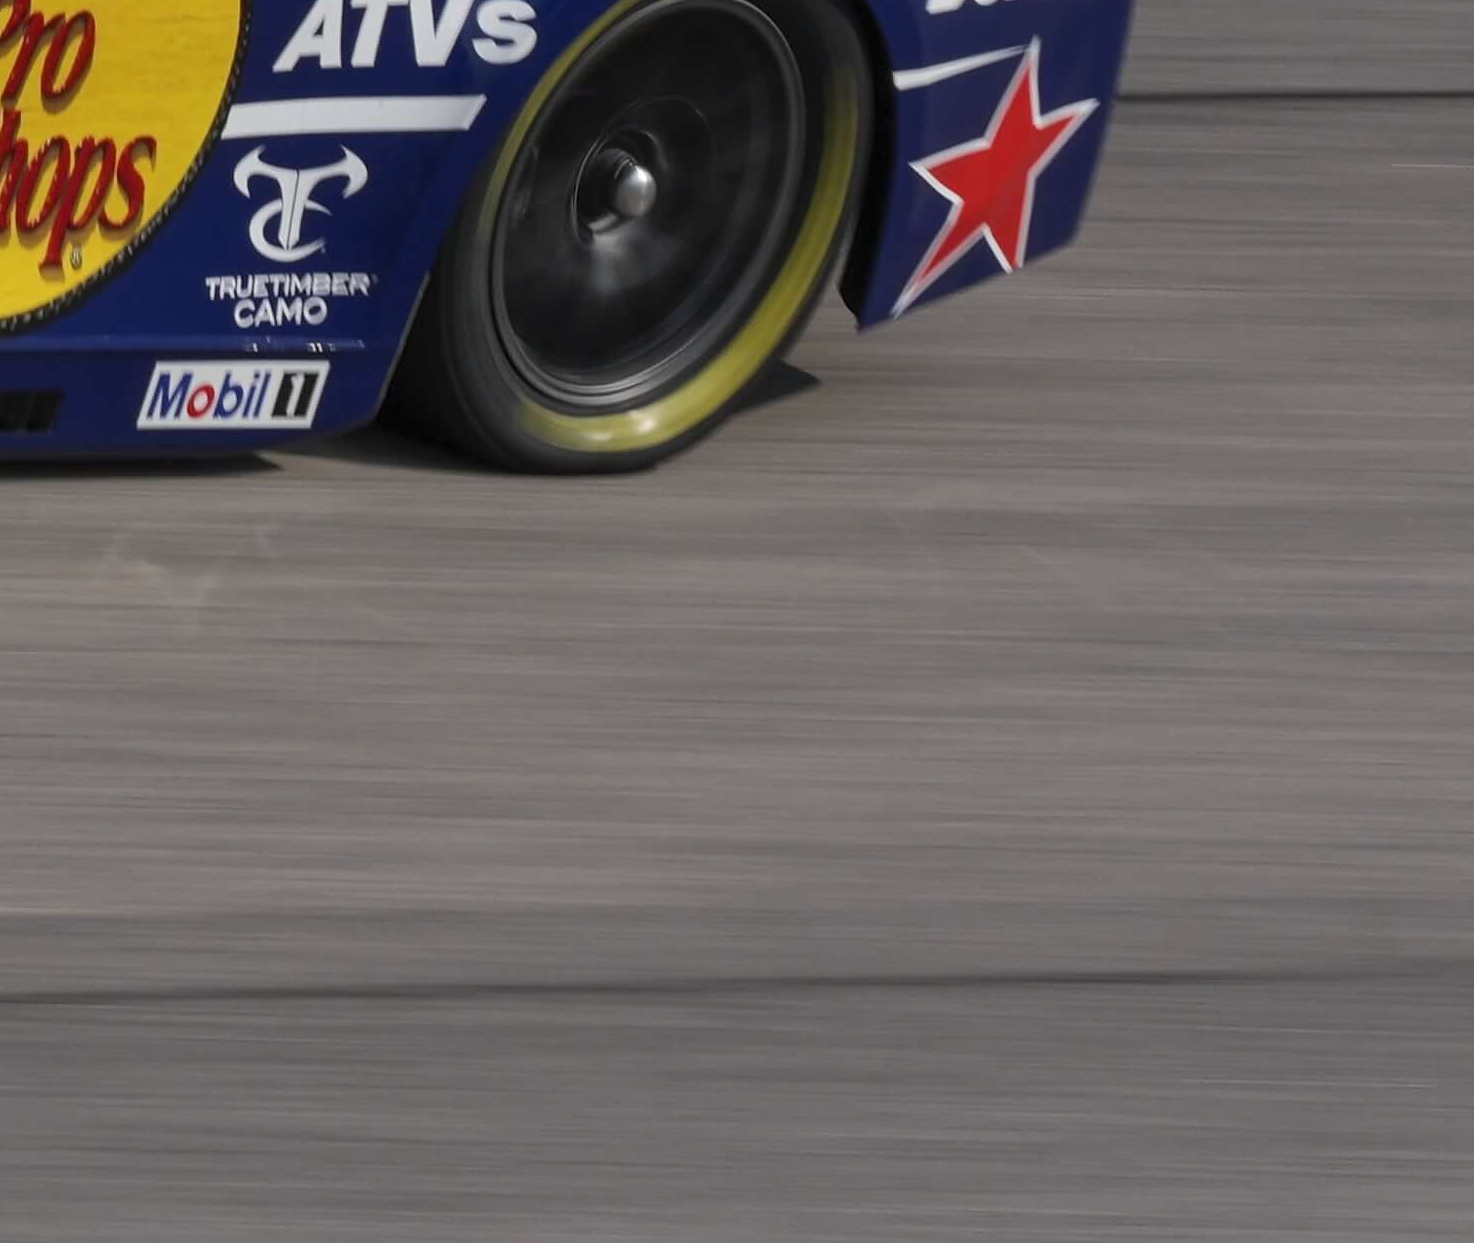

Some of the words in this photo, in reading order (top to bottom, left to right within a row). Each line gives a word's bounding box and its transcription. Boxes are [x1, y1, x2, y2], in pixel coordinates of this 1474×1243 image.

[205, 272, 371, 301] TRUETIMBER
[233, 296, 328, 329] CAMO
[145, 372, 271, 420] Mobil
[279, 372, 313, 419] 1
